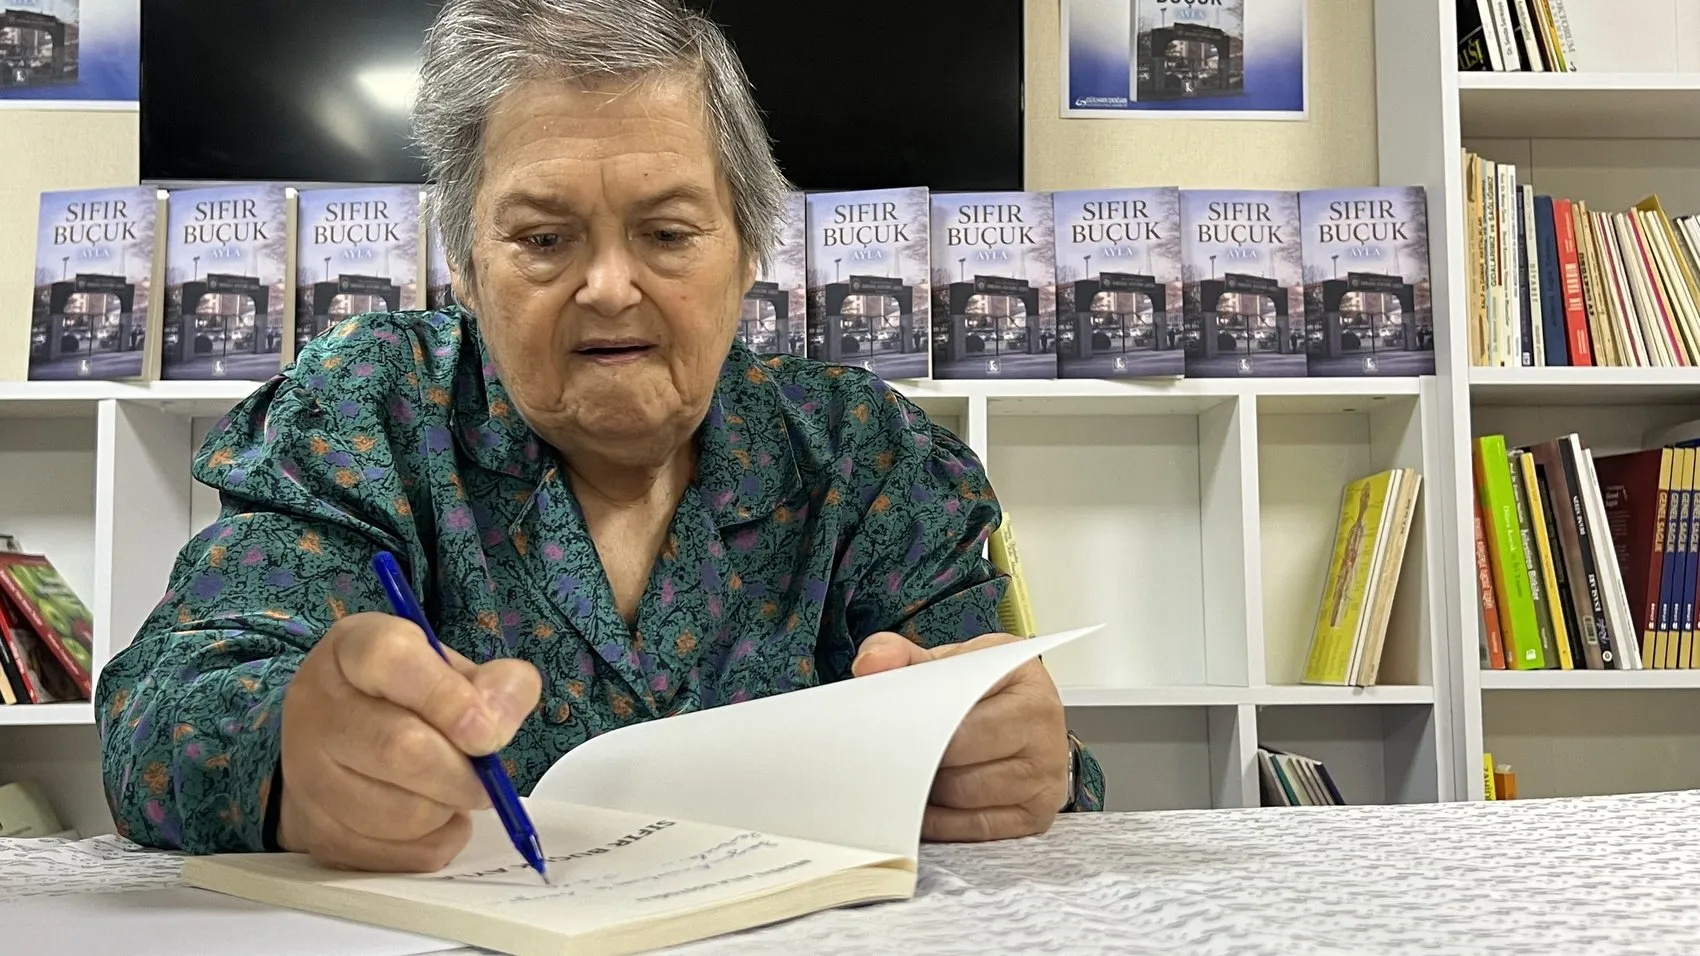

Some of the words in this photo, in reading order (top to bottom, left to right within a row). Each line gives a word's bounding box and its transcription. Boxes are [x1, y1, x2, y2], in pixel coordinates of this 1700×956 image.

[65, 199, 128, 221] SIFIR
[195, 198, 258, 220] SIFIR
[325, 200, 389, 220] SIFIR
[834, 202, 898, 224] SIFIR
[958, 204, 1024, 224] SIFIR
[1082, 200, 1149, 221] SIFIR
[1208, 202, 1272, 222] SIFIR
[1329, 200, 1396, 220] SIFIR
[54, 221, 137, 247] BUÇUK
[183, 220, 269, 247] BUÇUK
[314, 221, 400, 248] BUÇUK
[823, 224, 910, 248] BUÇUK
[947, 226, 1036, 249] BUÇUK
[1072, 222, 1162, 246] BUÇUK
[1198, 224, 1284, 247] BUÇUK
[1319, 222, 1409, 246] BUÇUK
[82, 247, 110, 259] AYLA
[212, 247, 241, 259] AYLA
[343, 247, 372, 259] AYLA
[851, 248, 882, 260] AYLA
[976, 250, 1008, 261] AYLA
[1102, 246, 1134, 258] AYLA
[1226, 247, 1257, 259] AYLA
[1349, 246, 1381, 258] AYLA
[1529, 263, 1539, 302] DİYABET
